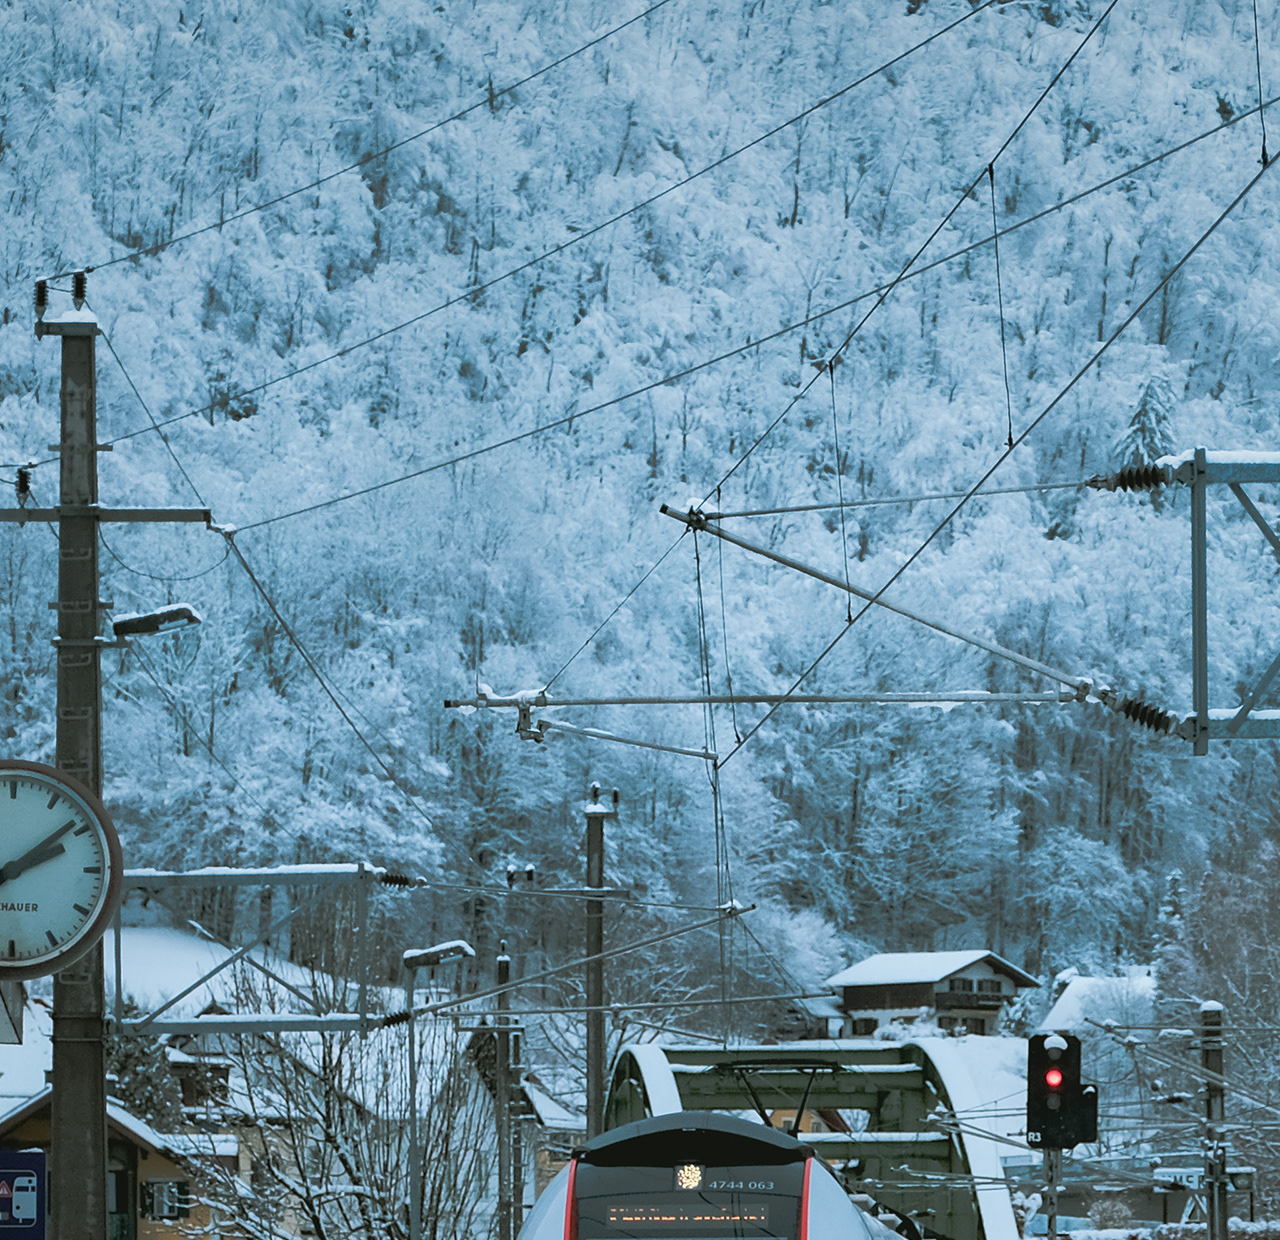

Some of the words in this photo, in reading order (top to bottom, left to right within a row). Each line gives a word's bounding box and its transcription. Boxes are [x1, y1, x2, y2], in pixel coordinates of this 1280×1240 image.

[1027, 1131, 1042, 1143] R3
[708, 1180, 744, 1190] 4744
[748, 1180, 775, 1190] 063
